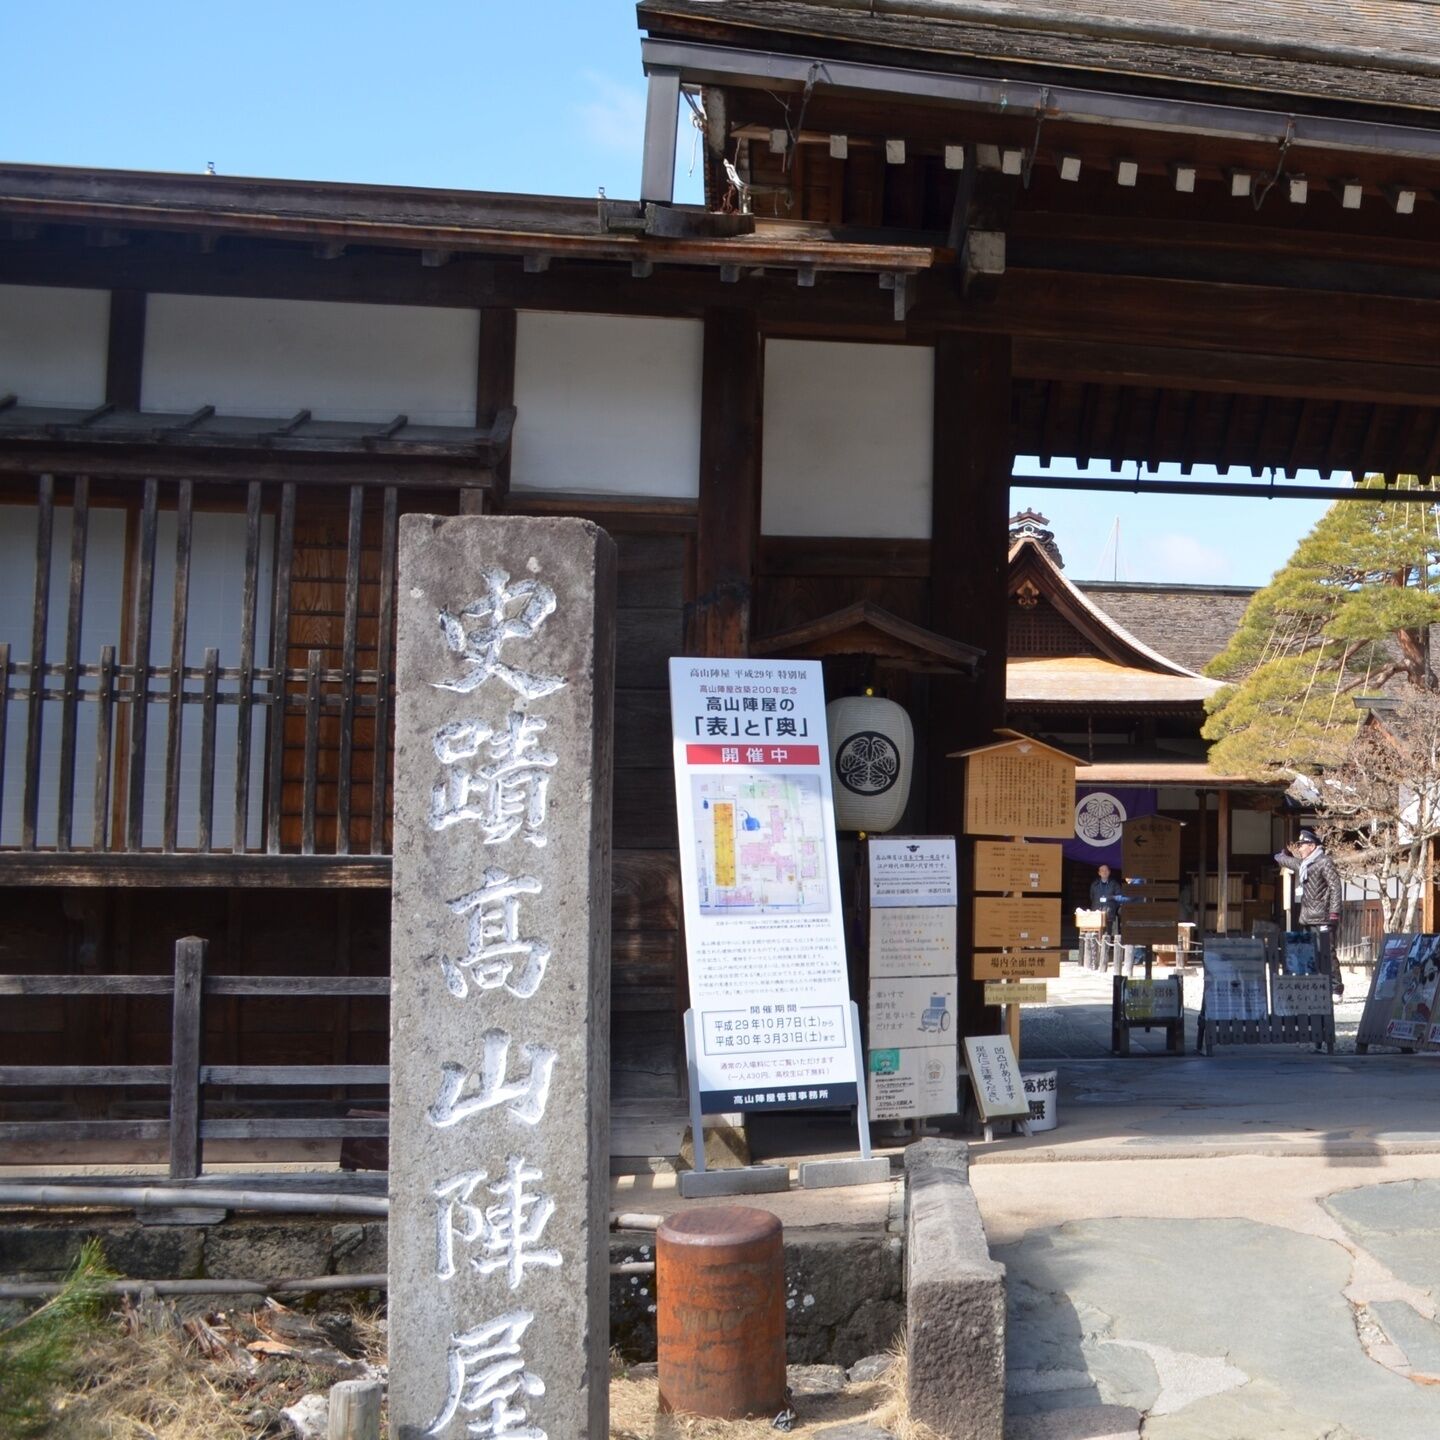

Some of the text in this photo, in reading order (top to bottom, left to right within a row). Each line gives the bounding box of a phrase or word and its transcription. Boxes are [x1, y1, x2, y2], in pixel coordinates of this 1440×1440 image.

[690, 668, 807, 680] 高山陣屋 平成29年 特別展
[699, 684, 798, 695] 高山陣屋改築200年記念
[706, 696, 795, 712] 高山陣屋の
[694, 716, 808, 737] 「表」と「奥」
[721, 747, 788, 763] 開催中
[991, 957, 1045, 968] 場内全面禁煙
[750, 1004, 798, 1015] 開催期間
[733, 1089, 829, 1105] 高山陣屋管理事務所
